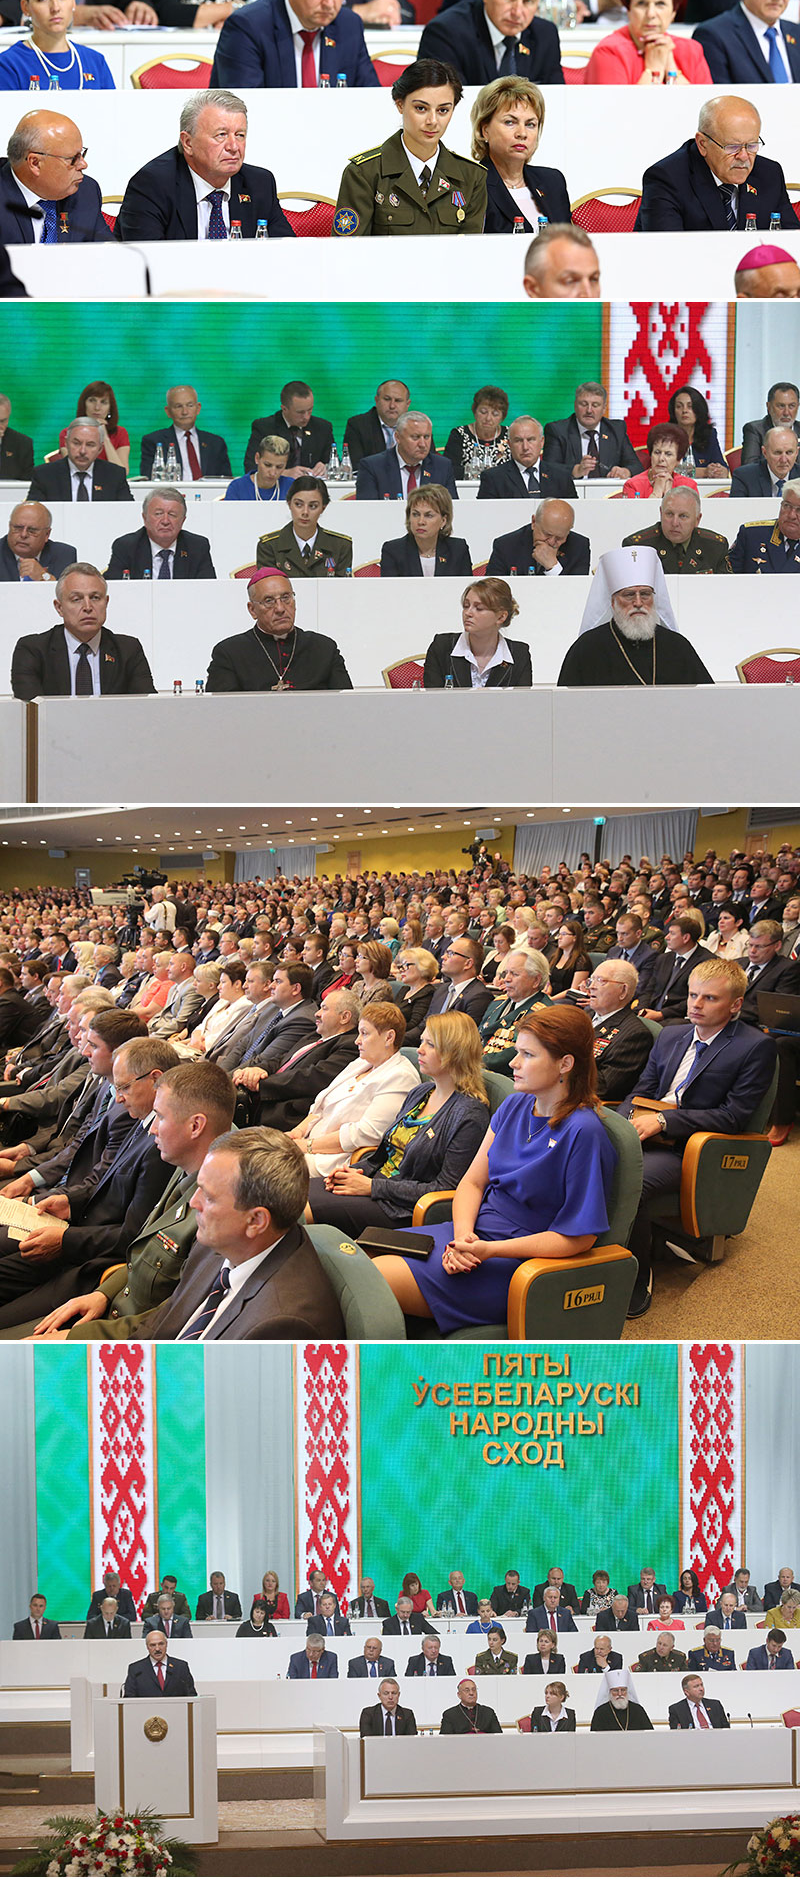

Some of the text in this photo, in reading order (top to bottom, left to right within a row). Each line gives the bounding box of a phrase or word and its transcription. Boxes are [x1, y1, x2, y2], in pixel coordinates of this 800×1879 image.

[723, 1156, 735, 1168] 17
[567, 1290, 602, 1308] 16 РЯД
[483, 1353, 570, 1376] ПЯТЫ
[412, 1376, 639, 1406] ЎСЕБЕЛАРУСКІ
[450, 1412, 604, 1440] НАРОДНЫ
[482, 1441, 565, 1468] СХОД
